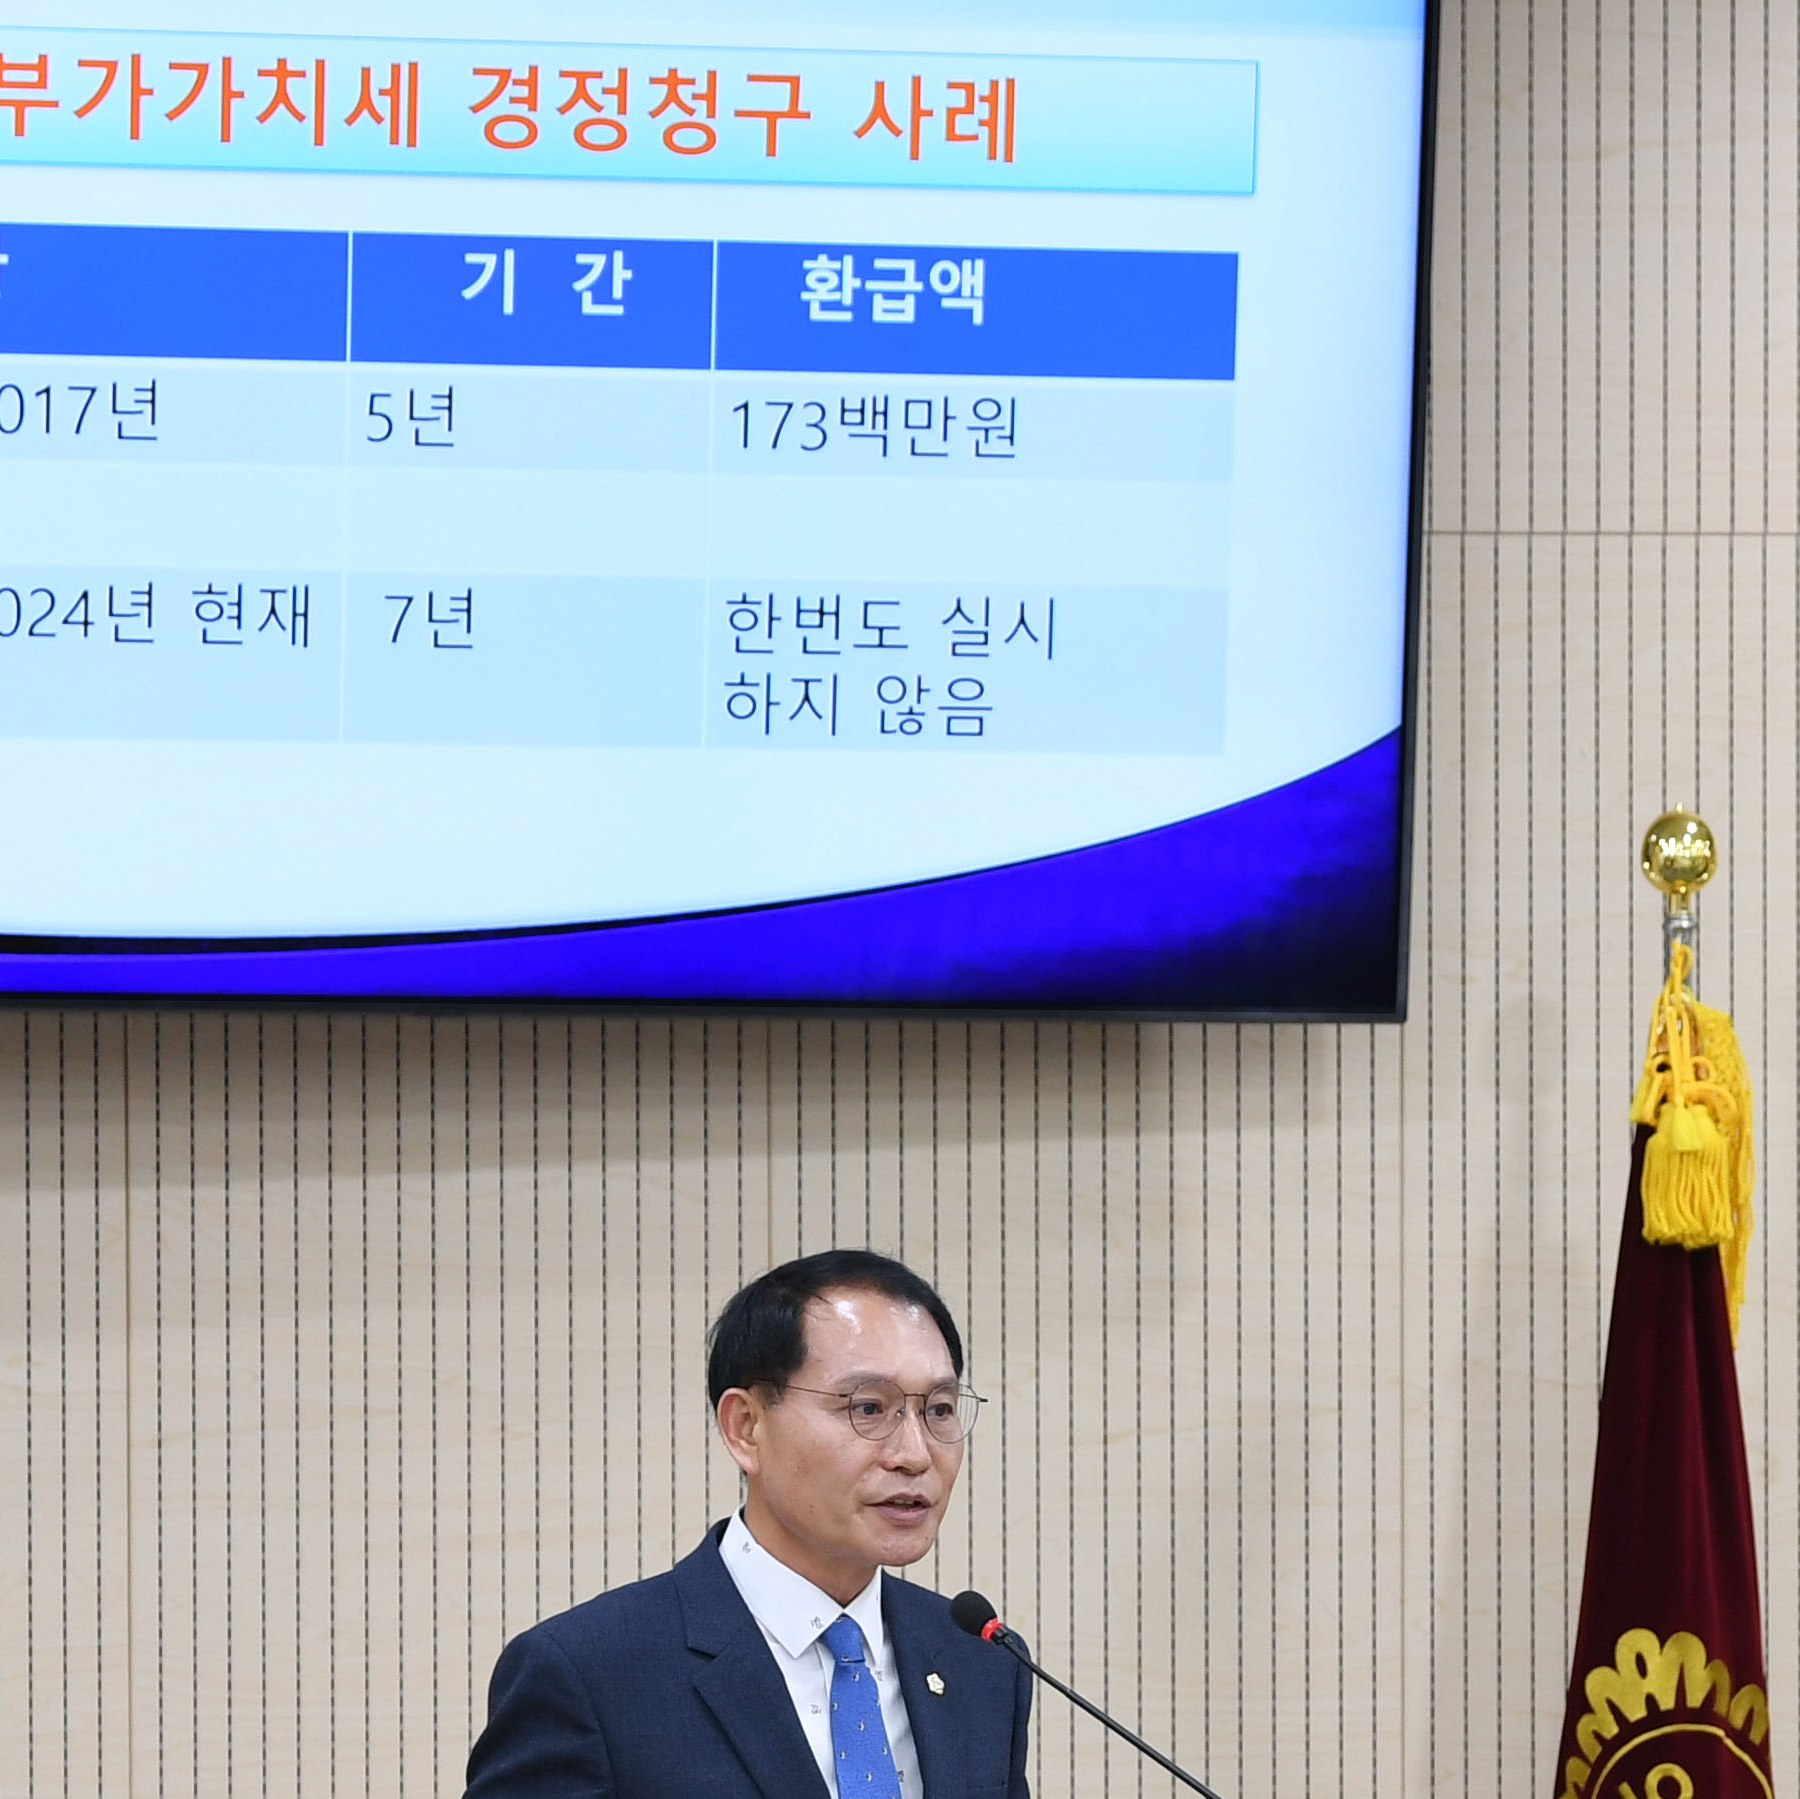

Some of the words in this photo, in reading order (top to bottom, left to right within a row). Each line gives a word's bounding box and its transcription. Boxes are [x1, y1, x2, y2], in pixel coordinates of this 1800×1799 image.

[469, 65, 813, 157] 경정청구
[854, 75, 1017, 163] 사례
[800, 253, 988, 326] 환급액
[366, 384, 456, 449] 5년
[731, 394, 1017, 460] 173백만원
[191, 582, 311, 650] 현재
[384, 587, 475, 651] 7년
[725, 591, 910, 657] 한번도
[941, 595, 1055, 662] 실시
[723, 671, 839, 738] 하지
[876, 674, 994, 738] 않음
